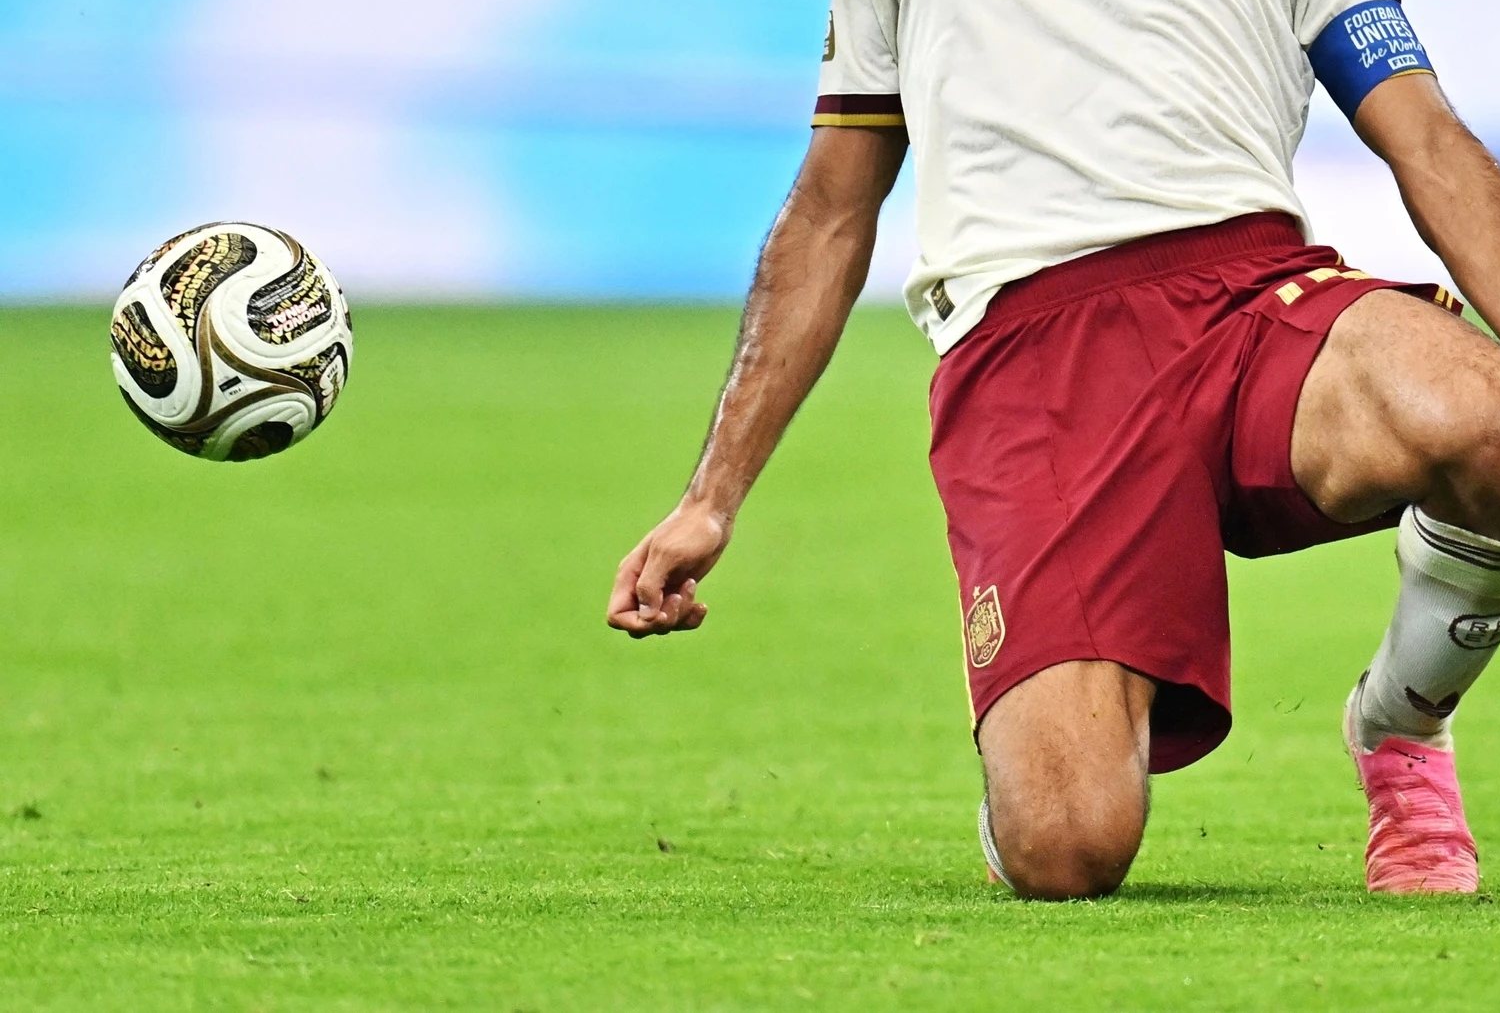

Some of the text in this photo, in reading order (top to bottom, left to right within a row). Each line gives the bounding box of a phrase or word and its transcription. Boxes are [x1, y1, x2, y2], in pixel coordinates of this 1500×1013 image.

[1344, 6, 1405, 34] FOOTBALL
[1350, 19, 1414, 51] UNITES
[1359, 45, 1388, 69] the
[1390, 56, 1417, 68] FIFA
[264, 299, 309, 327] FINAL
[270, 300, 328, 337] TRIONDA
